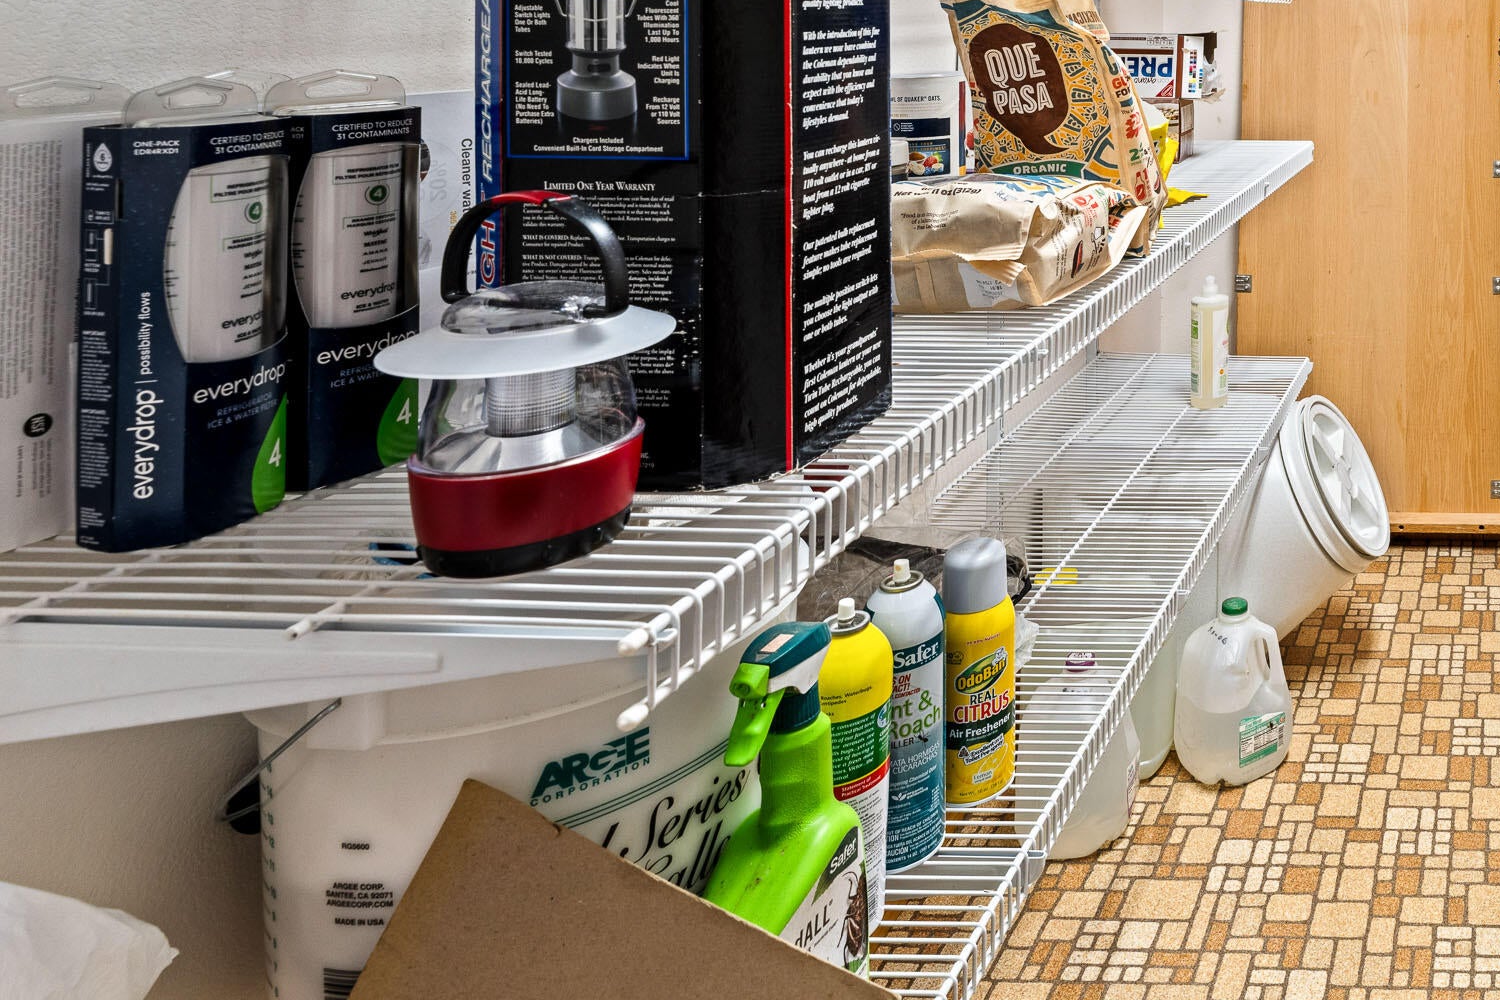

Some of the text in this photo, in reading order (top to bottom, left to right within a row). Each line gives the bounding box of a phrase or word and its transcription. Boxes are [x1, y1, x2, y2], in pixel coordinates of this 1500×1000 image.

[983, 41, 1045, 87] QUE
[992, 82, 1054, 116] PASA
[332, 118, 413, 133] CERTIFIED TO REDUCE
[348, 127, 410, 139] CONTAMINANTS
[133, 140, 180, 148] ONE-PACK
[210, 130, 285, 147] CERTIFIED TO REDUCE
[214, 139, 282, 154] 31 CONTAMINANTS
[461, 138, 472, 186] Cleaner
[1012, 163, 1067, 175] ORGANIC
[544, 181, 655, 191] LIMITED ONE YEAR WARRANTY
[193, 362, 286, 404] everydrop
[126, 291, 164, 500] everydrop possibility flows
[217, 392, 273, 416] REFRIGERATOR
[207, 417, 223, 429] ICE
[234, 408, 255, 425] WATER
[397, 398, 410, 425] 4
[268, 438, 281, 468] 4
[893, 641, 939, 669] Safer
[898, 674, 911, 685] ON
[957, 659, 1006, 692] OdoBan
[891, 689, 933, 719] nt &
[953, 690, 1010, 724] CITRUS
[970, 689, 997, 705] REAL
[950, 712, 1011, 739] Air Freshener
[531, 727, 650, 799] ARGEE
[892, 752, 938, 775] CUCARACHAS
[908, 741, 940, 765] HORMIGAS
[530, 757, 650, 808] CORPORATION
[633, 768, 750, 865] Series
[341, 842, 370, 850] RG5600
[828, 837, 858, 875] Safer
[326, 890, 357, 900] SANTEE,
[333, 882, 384, 891] ARGEE CORP.
[326, 899, 393, 909] ARGEECORP.COM
[334, 917, 355, 926] MADE
[367, 918, 384, 926] USA
